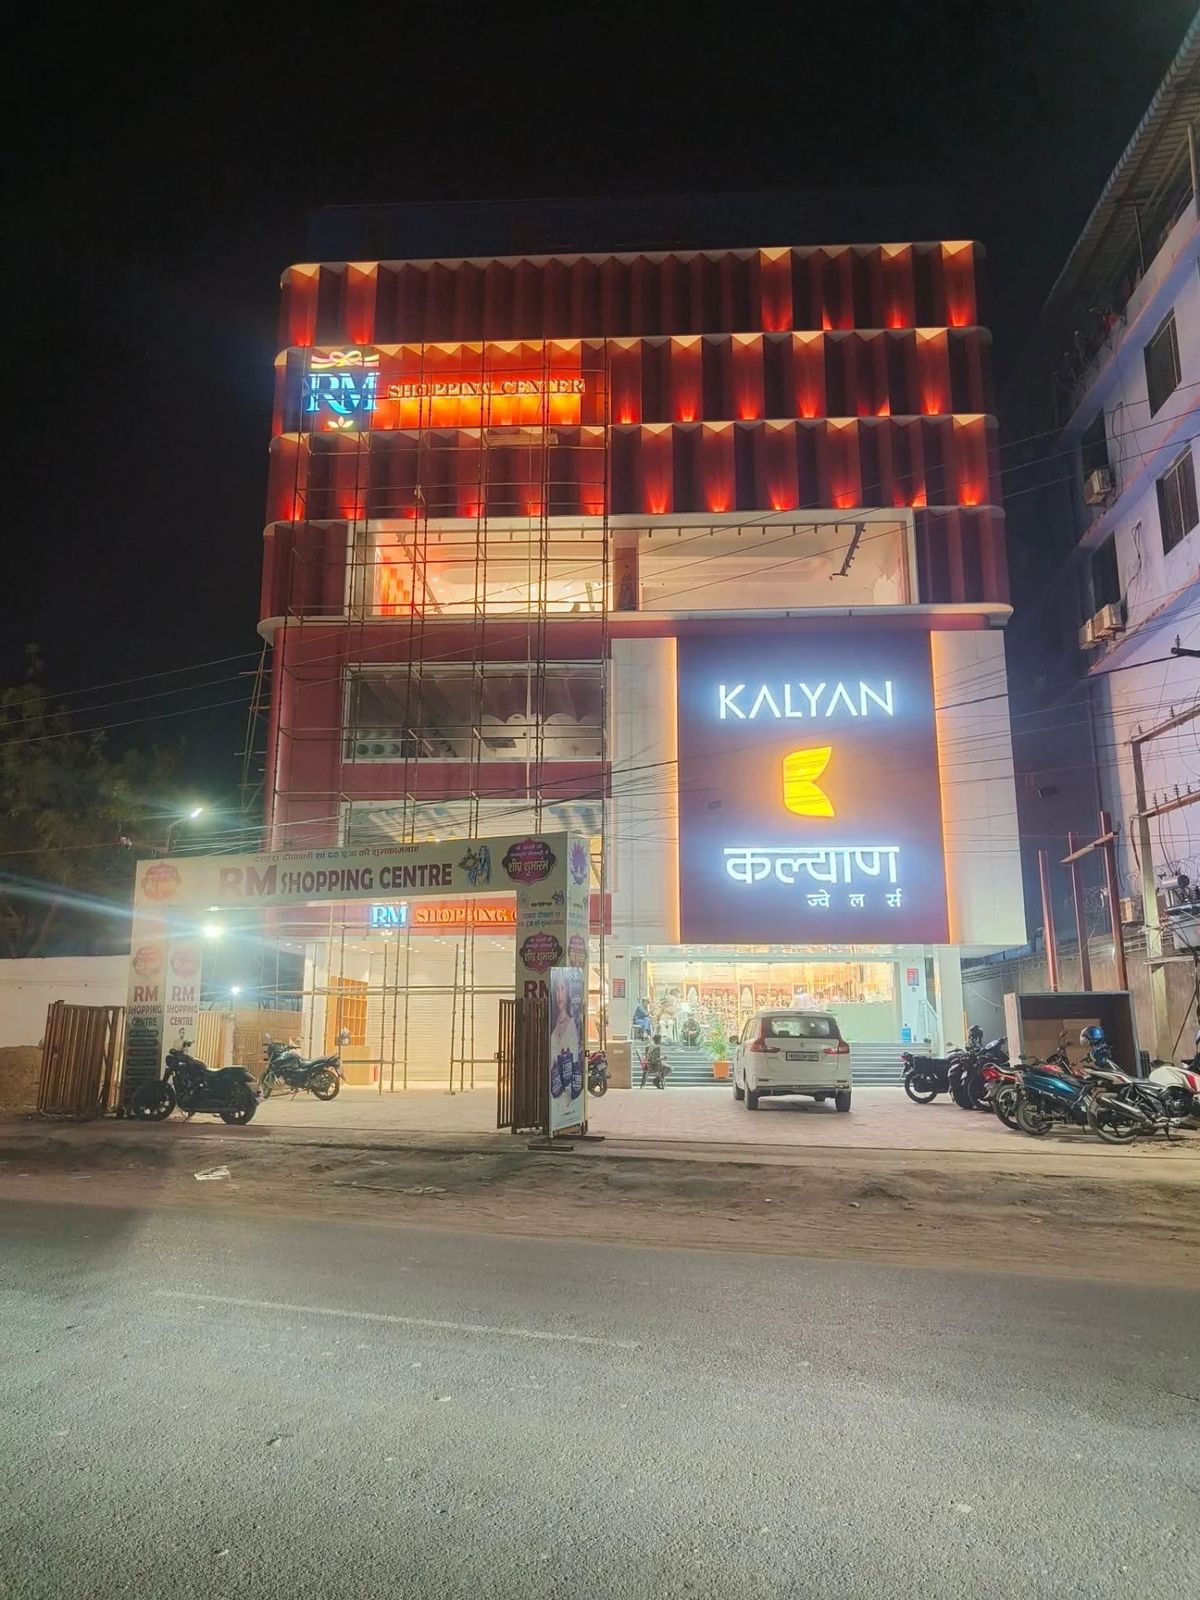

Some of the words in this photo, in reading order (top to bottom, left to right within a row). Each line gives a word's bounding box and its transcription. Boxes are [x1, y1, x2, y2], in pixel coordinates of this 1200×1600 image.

[306, 372, 380, 414] RM
[388, 382, 492, 400] SHOPPING
[501, 379, 585, 395] CENTER
[718, 681, 895, 719] KALYAN
[724, 846, 899, 884] कल्याण
[219, 865, 278, 897] RM
[281, 867, 373, 894] SHOPPING
[379, 862, 453, 889] CENTRE
[371, 905, 408, 928] RM
[133, 986, 158, 1002] RM
[171, 986, 195, 1001] RM
[128, 1004, 162, 1015] SHOPPING
[166, 1004, 198, 1014] SHOPPING
[132, 1016, 157, 1026] CENTRE
[170, 1016, 193, 1026] CENTRE
